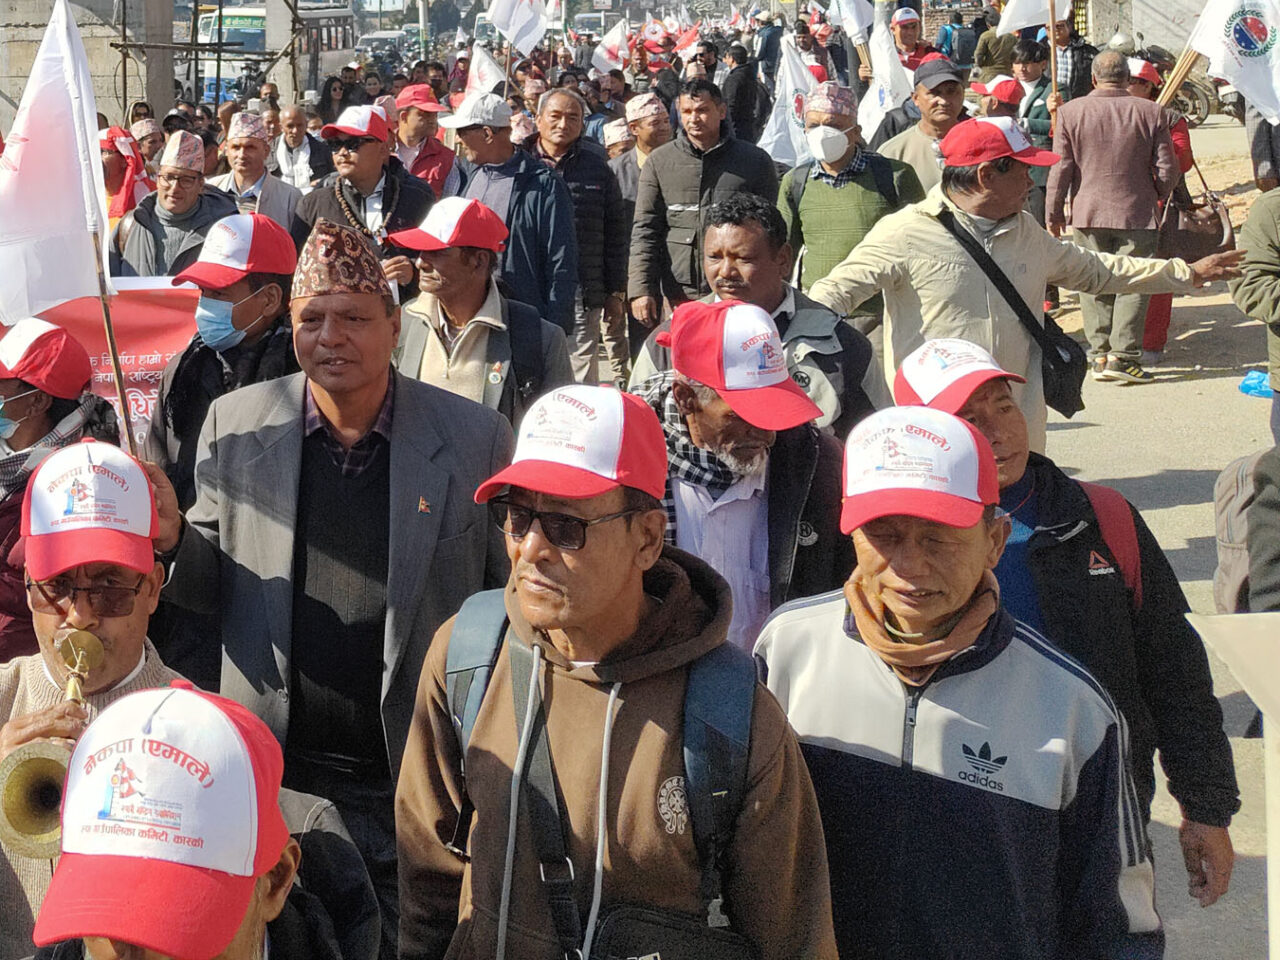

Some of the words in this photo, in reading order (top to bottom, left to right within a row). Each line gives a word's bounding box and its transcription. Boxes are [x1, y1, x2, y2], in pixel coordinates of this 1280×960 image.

[83, 738, 135, 777] नेकपा
[140, 737, 215, 790] (एमाले)
[957, 770, 1005, 792] adidas
